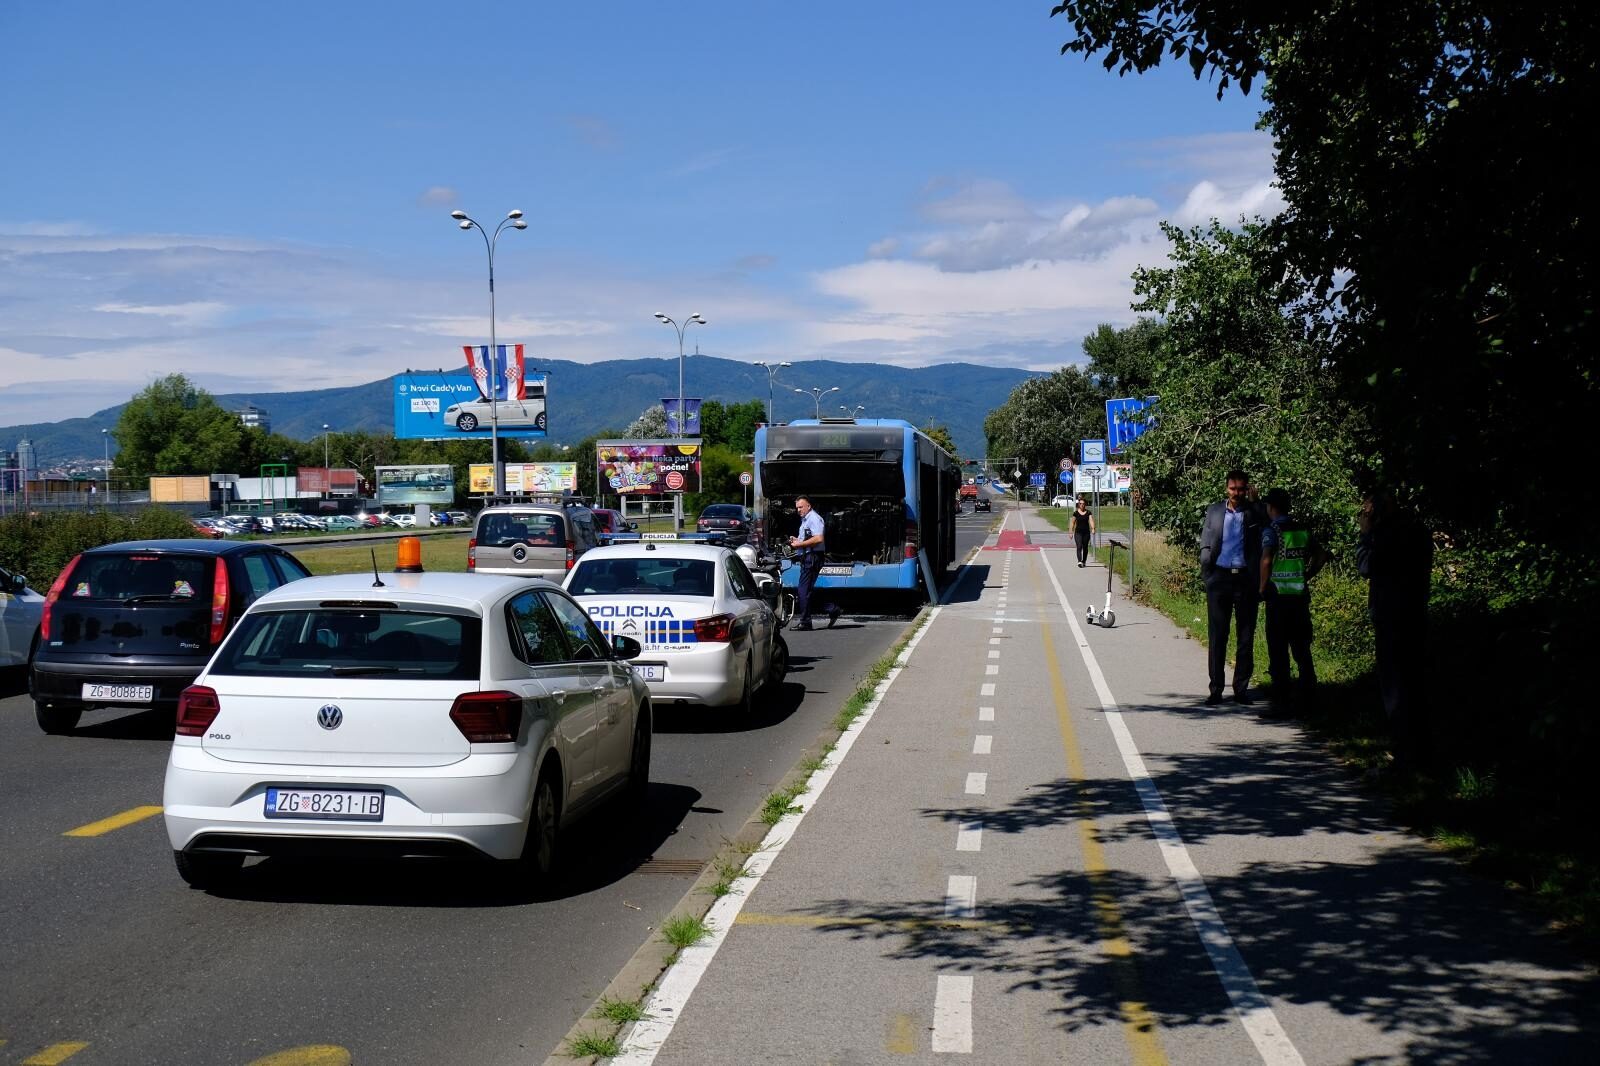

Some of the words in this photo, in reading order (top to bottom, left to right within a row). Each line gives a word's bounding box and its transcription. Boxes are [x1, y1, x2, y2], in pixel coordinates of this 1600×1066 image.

[410, 384, 429, 392] Novi
[430, 384, 455, 393] Caddy
[456, 384, 472, 392] Van
[674, 455, 697, 464] party
[660, 463, 689, 472] počne!
[587, 605, 675, 618] POLICIJA
[180, 642, 200, 650] Punto
[90, 685, 104, 697] ZG
[277, 792, 300, 812] ZG
